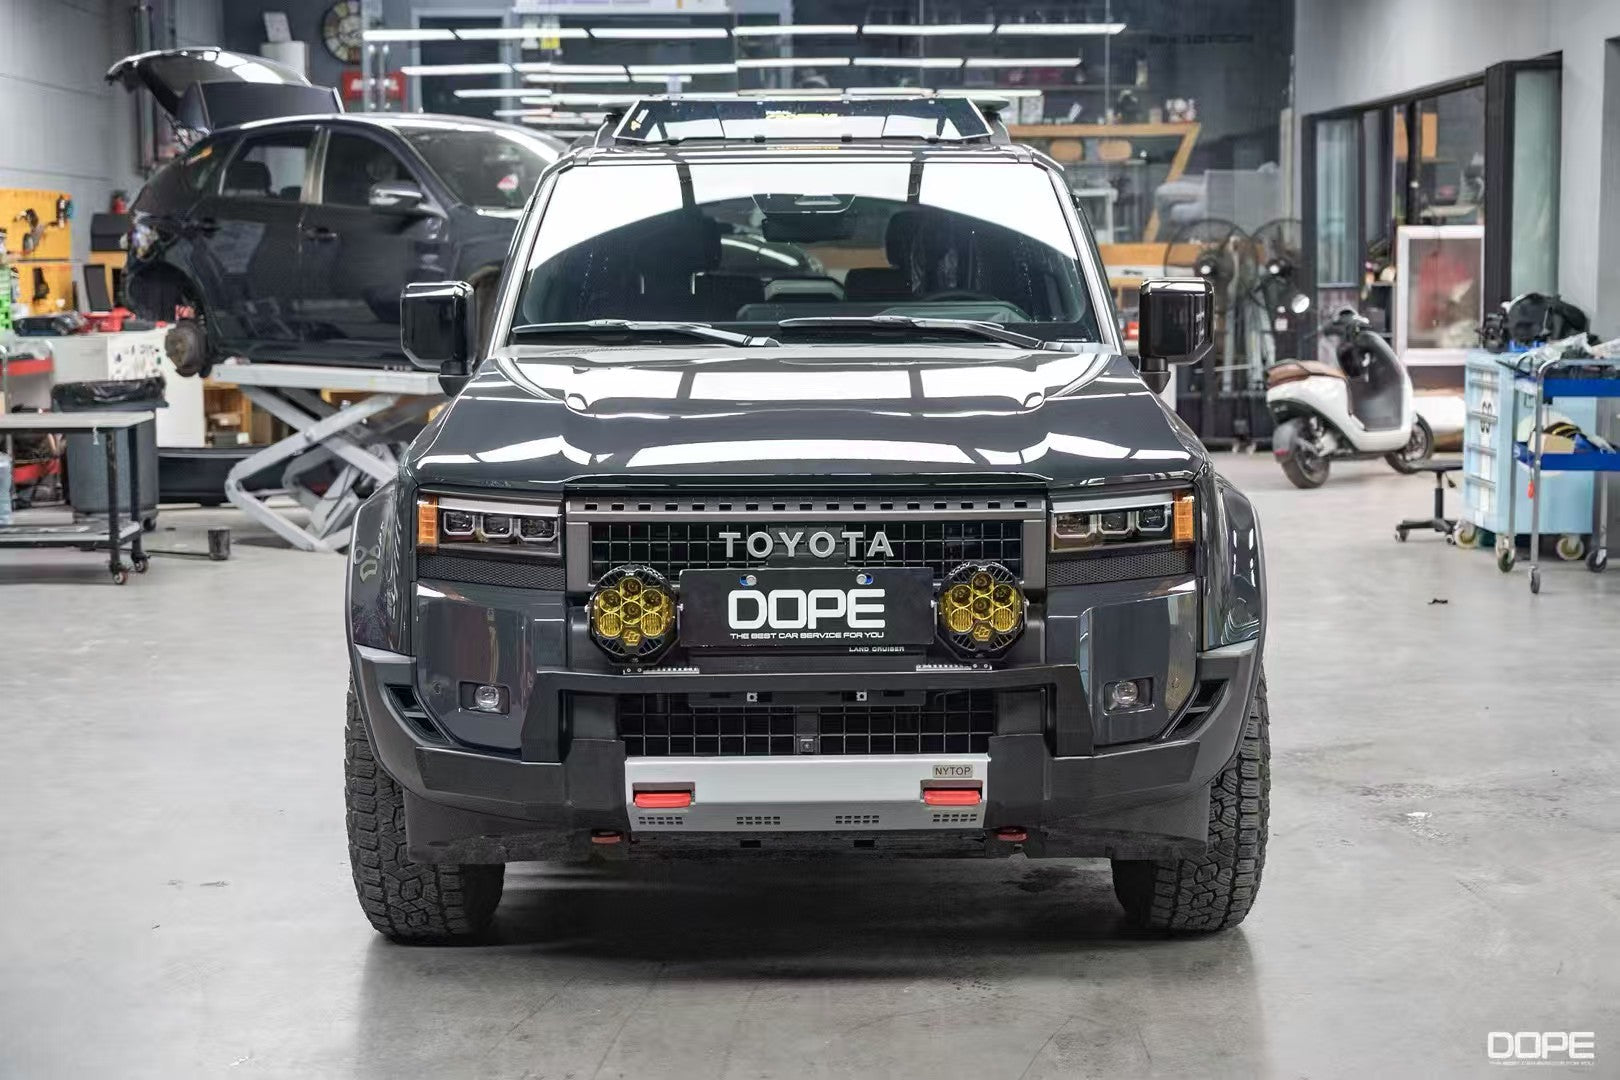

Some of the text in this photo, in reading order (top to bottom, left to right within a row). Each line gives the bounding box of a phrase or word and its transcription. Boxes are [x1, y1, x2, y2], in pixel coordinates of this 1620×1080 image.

[718, 531, 895, 558] TOYOTA
[728, 588, 886, 630] DOPE
[935, 766, 971, 776] NYTOP
